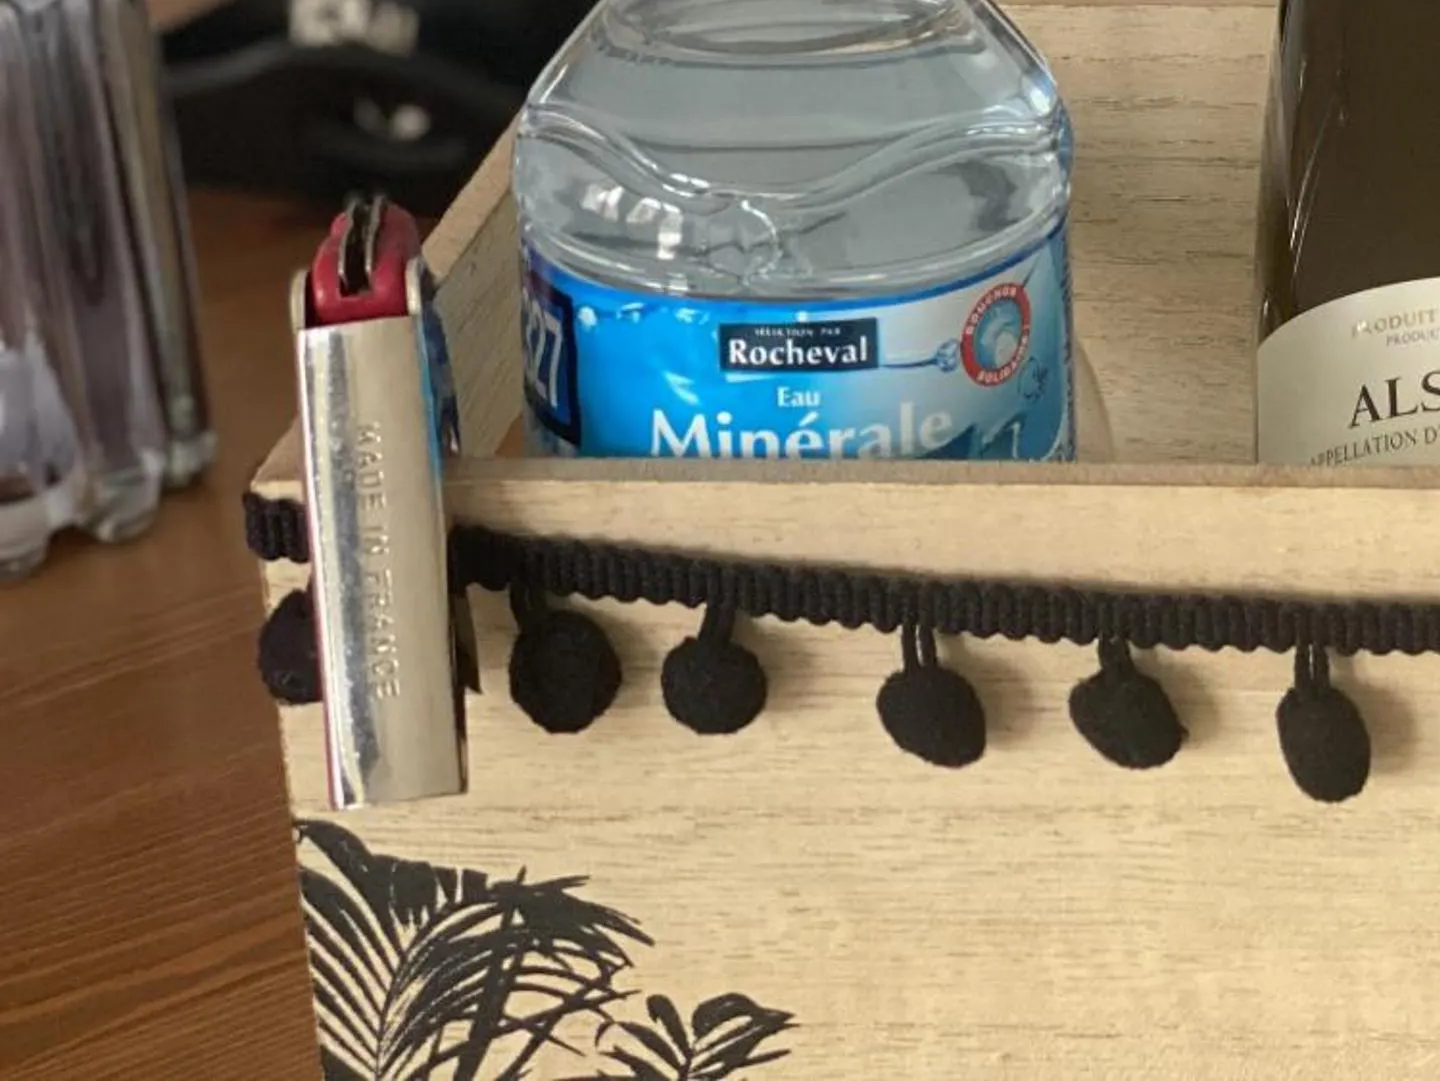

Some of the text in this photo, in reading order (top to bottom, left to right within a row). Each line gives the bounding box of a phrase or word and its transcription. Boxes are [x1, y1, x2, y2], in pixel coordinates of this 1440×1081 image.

[1351, 308, 1437, 339] PRODUIT
[728, 335, 868, 366] Rocheval
[777, 385, 821, 408] Eau
[651, 400, 953, 460] Minérale
[357, 421, 400, 700] MADE IN FRANCE
